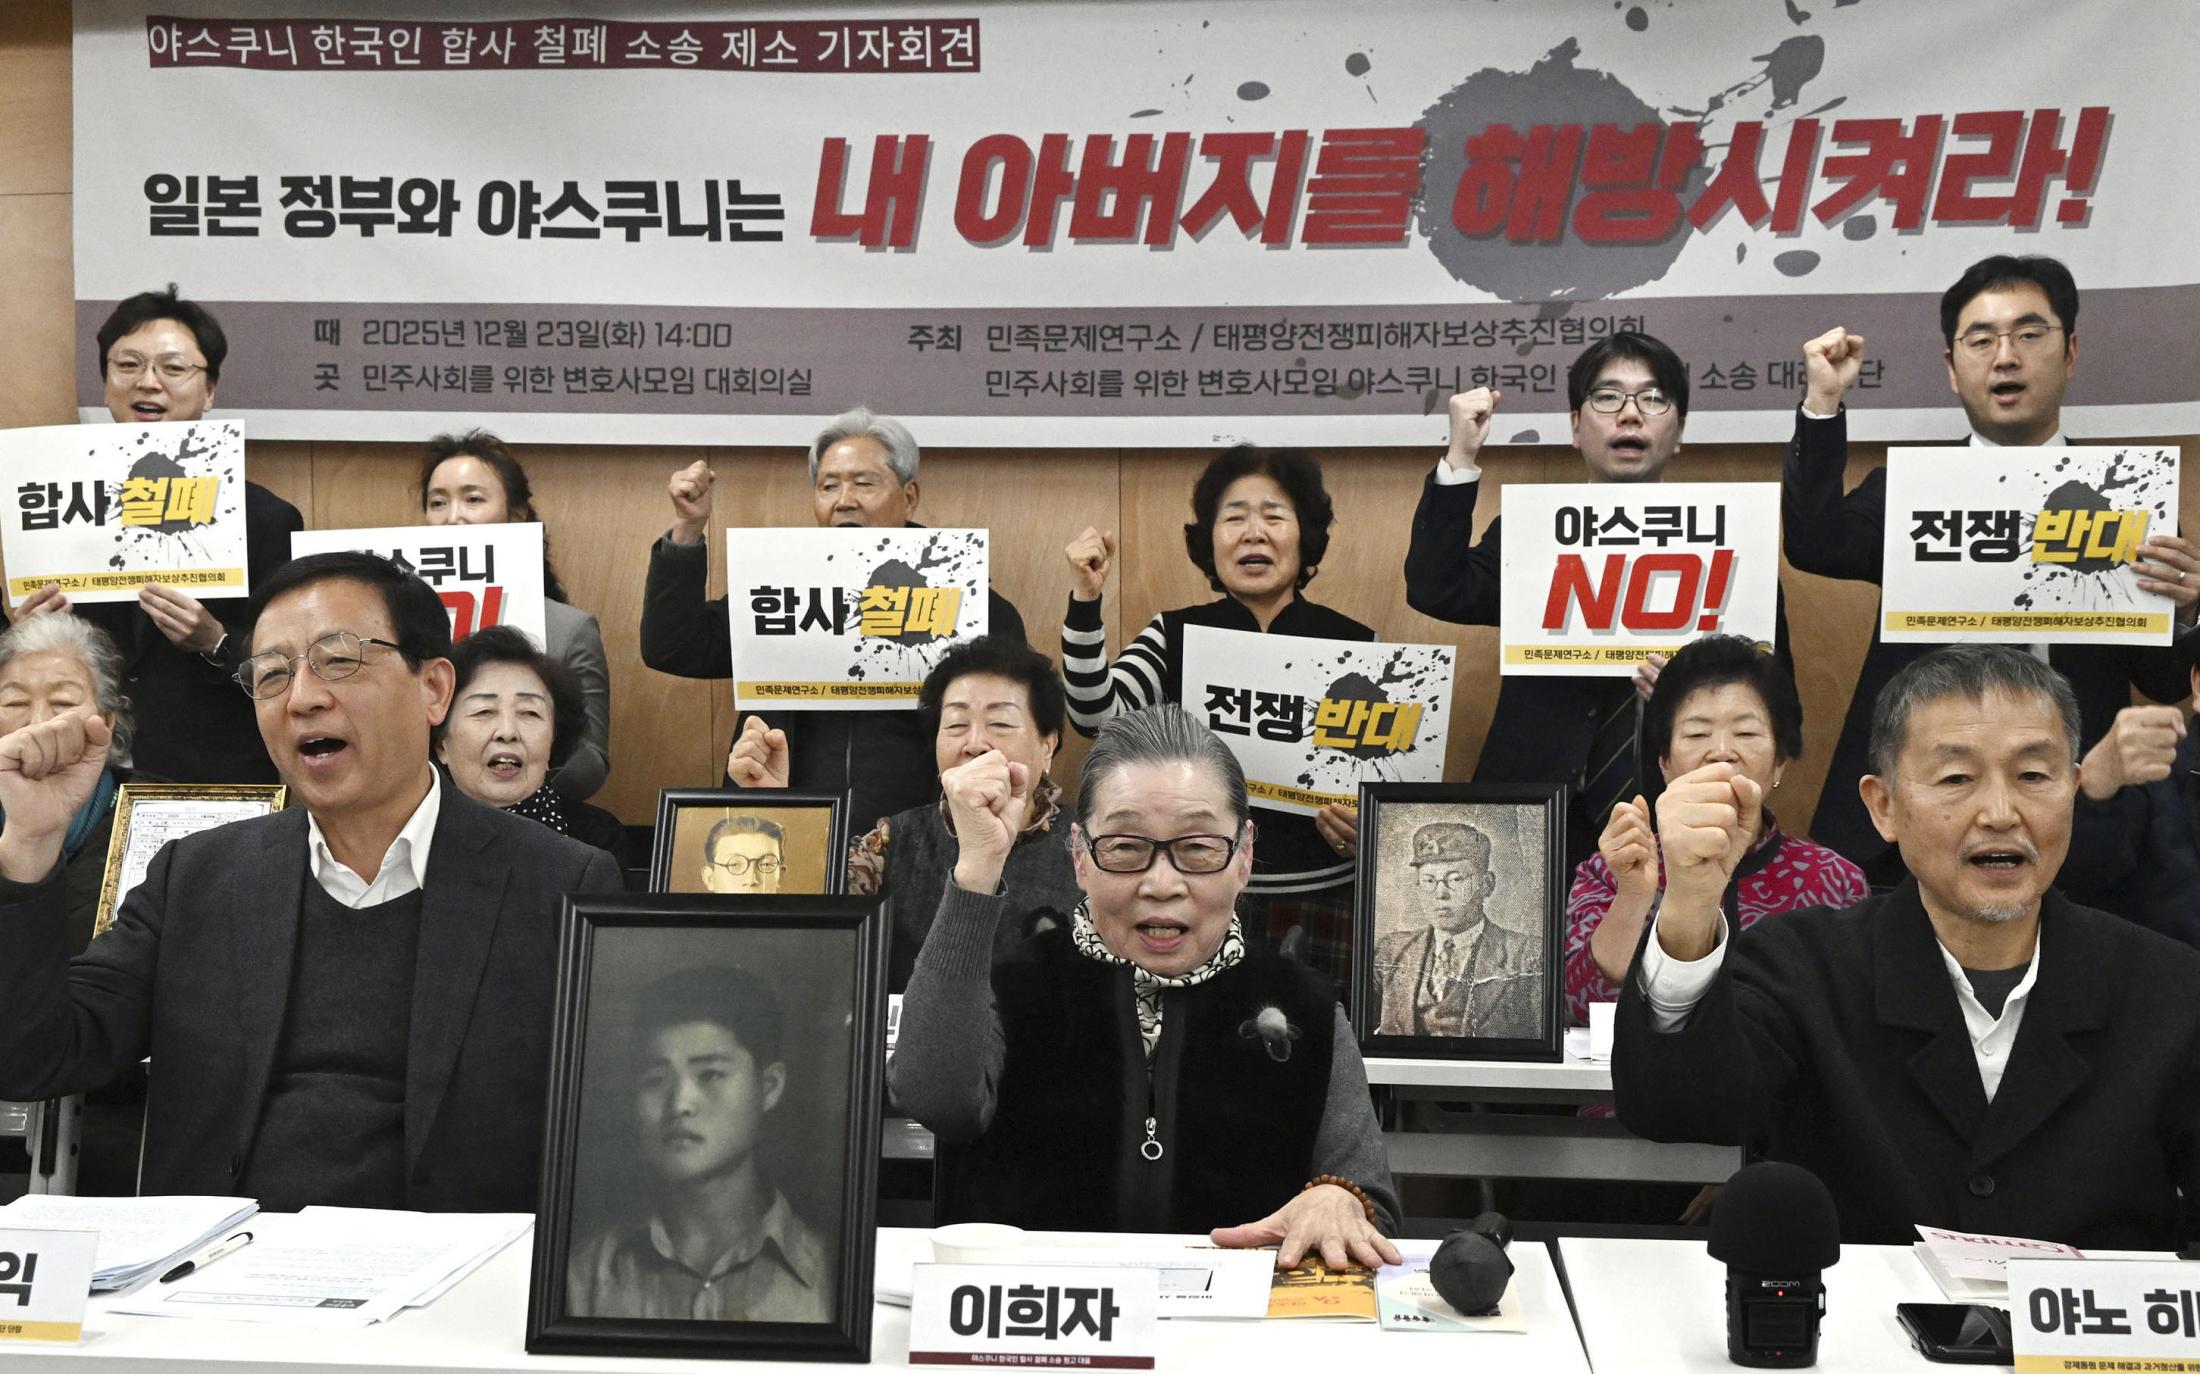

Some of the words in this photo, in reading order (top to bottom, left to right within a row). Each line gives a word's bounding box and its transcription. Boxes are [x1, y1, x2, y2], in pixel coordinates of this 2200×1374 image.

[149, 23, 298, 66] 야스쿠니
[311, 25, 422, 66] 한국인
[442, 26, 516, 65] 합사
[533, 25, 607, 65] 철폐
[625, 29, 704, 65] 소송
[721, 28, 799, 67] 제소
[817, 25, 975, 68] 기자회견
[144, 173, 262, 237] 일본
[279, 173, 460, 238] 정부와
[478, 179, 785, 242] 야스쿠니는
[810, 134, 933, 252] 내
[954, 127, 1429, 251] 아버지를
[1452, 106, 2111, 246] 해방시켜라!
[314, 318, 341, 347] 때
[362, 319, 466, 348] 2025년
[474, 320, 528, 349] 12월
[537, 319, 646, 349] 23일(화)
[655, 321, 732, 348] 14:00
[907, 324, 962, 352] 주최
[987, 323, 1182, 352] 민족문제연구소
[1190, 323, 1204, 353] /
[313, 363, 341, 392] 곳
[362, 364, 495, 393] 민주사회를
[503, 365, 555, 394] 위한
[563, 365, 695, 395] 변호사모임
[704, 367, 813, 397] 대회의실
[986, 369, 1125, 398] 민주사회를
[1133, 369, 1189, 397] 위한
[1198, 366, 1337, 398] 변호사모임
[1347, 365, 1461, 395] 야스쿠니
[1471, 364, 1556, 394] 한국인
[1699, 361, 1758, 391] 소송
[1767, 358, 1886, 391] 대단
[17, 480, 111, 531] 합사
[120, 476, 221, 526] 철폐
[1555, 505, 1726, 547] 야스쿠니
[1909, 510, 2021, 563] 전쟁
[2031, 509, 2151, 563] 반대
[92, 572, 226, 587] 태평양전쟁피해자보상추진협의회
[1541, 549, 1739, 635] NO!
[750, 585, 850, 636] 합사
[859, 585, 964, 637] 철폐
[1905, 615, 1978, 627] 민족문제연구소
[1991, 615, 2148, 628] 태평양전쟁피해자보상추진협의회
[1524, 649, 1592, 660] 민족문제연구소
[755, 685, 819, 696] 민족문제연구소
[1204, 684, 1305, 744] 전쟁
[1312, 697, 1425, 751] 반대
[948, 1284, 1120, 1342] 이희자
[2029, 1287, 2132, 1335] 야노
[2144, 1288, 2200, 1338] 히
